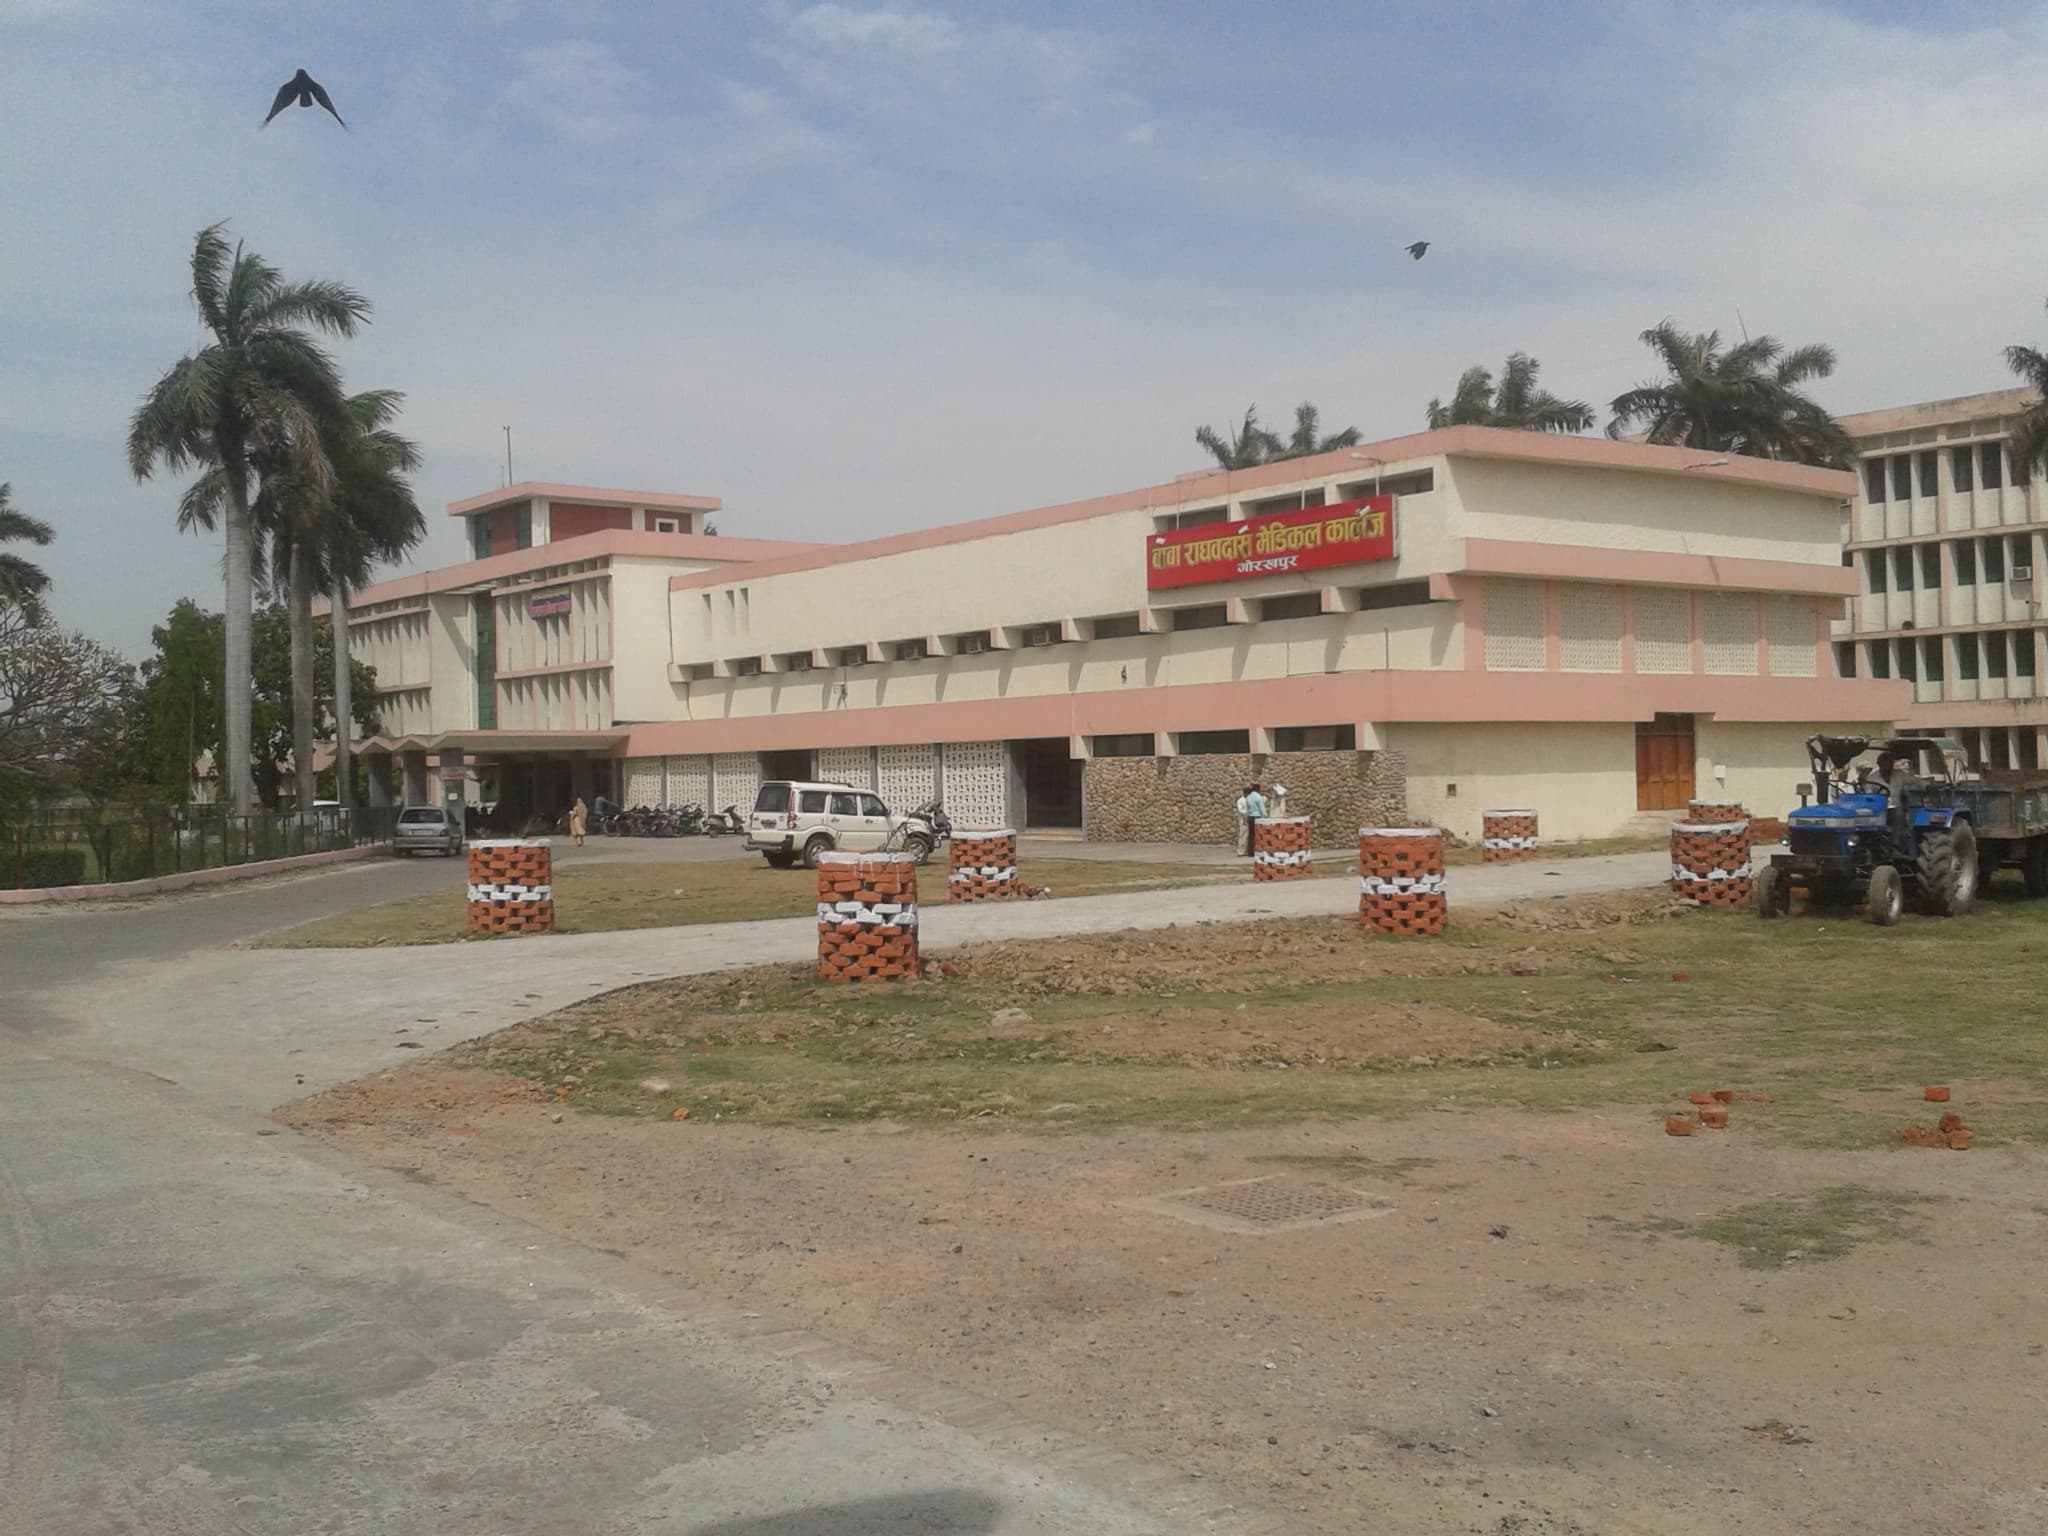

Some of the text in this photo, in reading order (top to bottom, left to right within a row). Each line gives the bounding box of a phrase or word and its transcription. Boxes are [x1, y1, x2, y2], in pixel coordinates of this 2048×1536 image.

[1151, 544, 1181, 568] बाबा
[1184, 533, 1253, 566] राघवदास
[1256, 521, 1322, 554] मेडिकल
[1236, 555, 1299, 573] गोरखपुर
